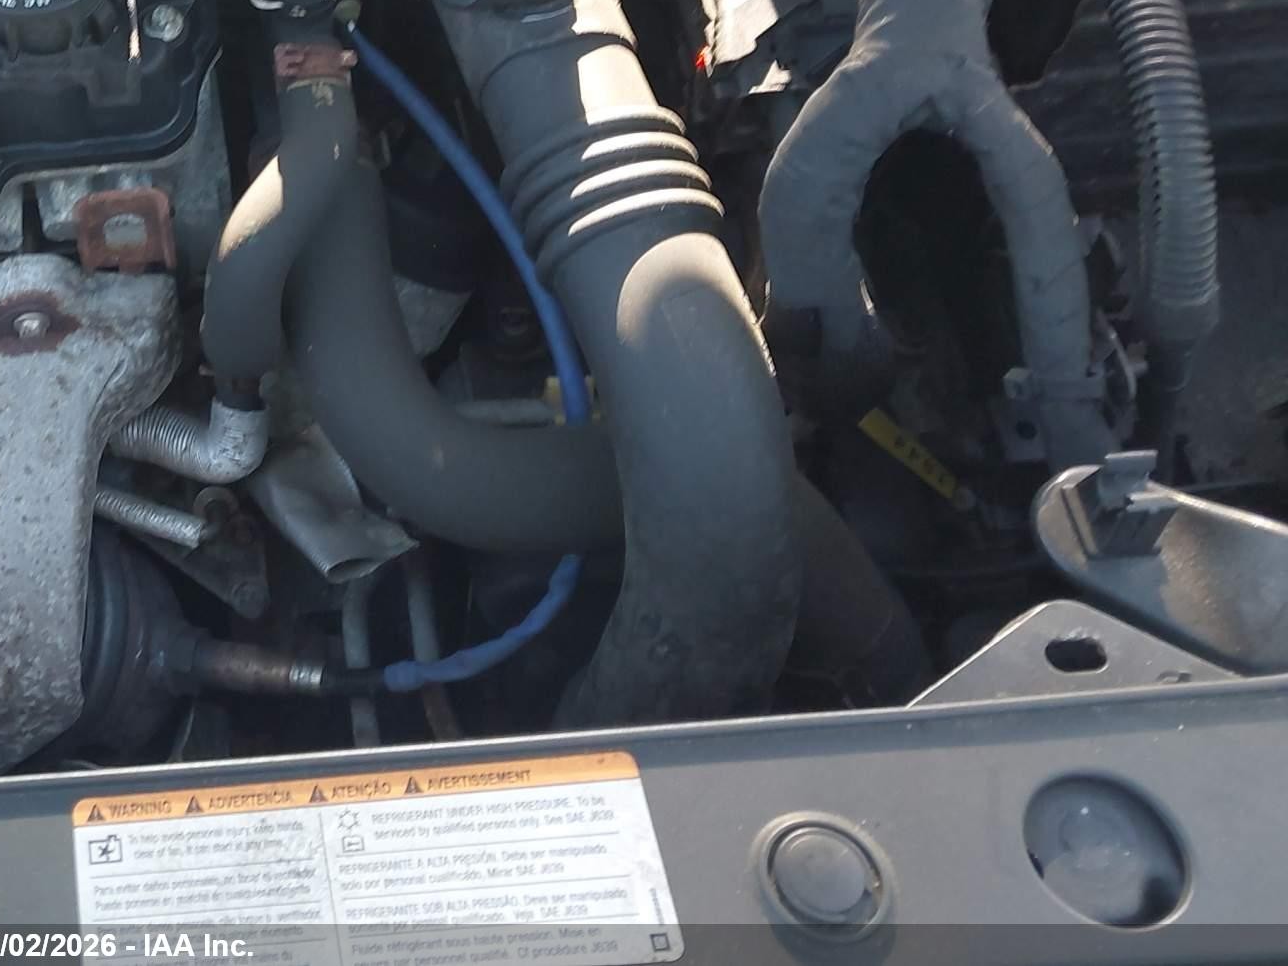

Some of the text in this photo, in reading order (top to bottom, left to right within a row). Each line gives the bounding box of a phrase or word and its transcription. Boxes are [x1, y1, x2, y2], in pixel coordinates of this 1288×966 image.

[107, 769, 530, 818] WARNING ADVERTENCIA ATENÇÃO AVERTISSEMENT
[371, 808, 443, 824] REFRIGERANT
[447, 805, 481, 817] UNDER
[486, 802, 511, 813] HIGH
[577, 795, 587, 805] To
[592, 794, 603, 804] be
[374, 827, 414, 840] serviced
[419, 826, 429, 838] by
[433, 822, 474, 836] qualified
[476, 818, 516, 832] persons
[544, 814, 561, 825] See
[566, 812, 584, 823] SAE
[338, 859, 412, 874] REFRIGERANTE
[426, 856, 448, 867] ALTA
[502, 849, 526, 860] Debe
[531, 847, 545, 858] ser
[341, 880, 361, 890] solo
[365, 878, 379, 890] por
[384, 874, 424, 887] personal
[516, 865, 535, 875] SAE
[346, 904, 417, 920] REFRIGERANTE
[423, 902, 442, 914] SOB
[446, 900, 467, 912] ALTA
[541, 906, 559, 917] SAE
[474, 933, 503, 944] haute
